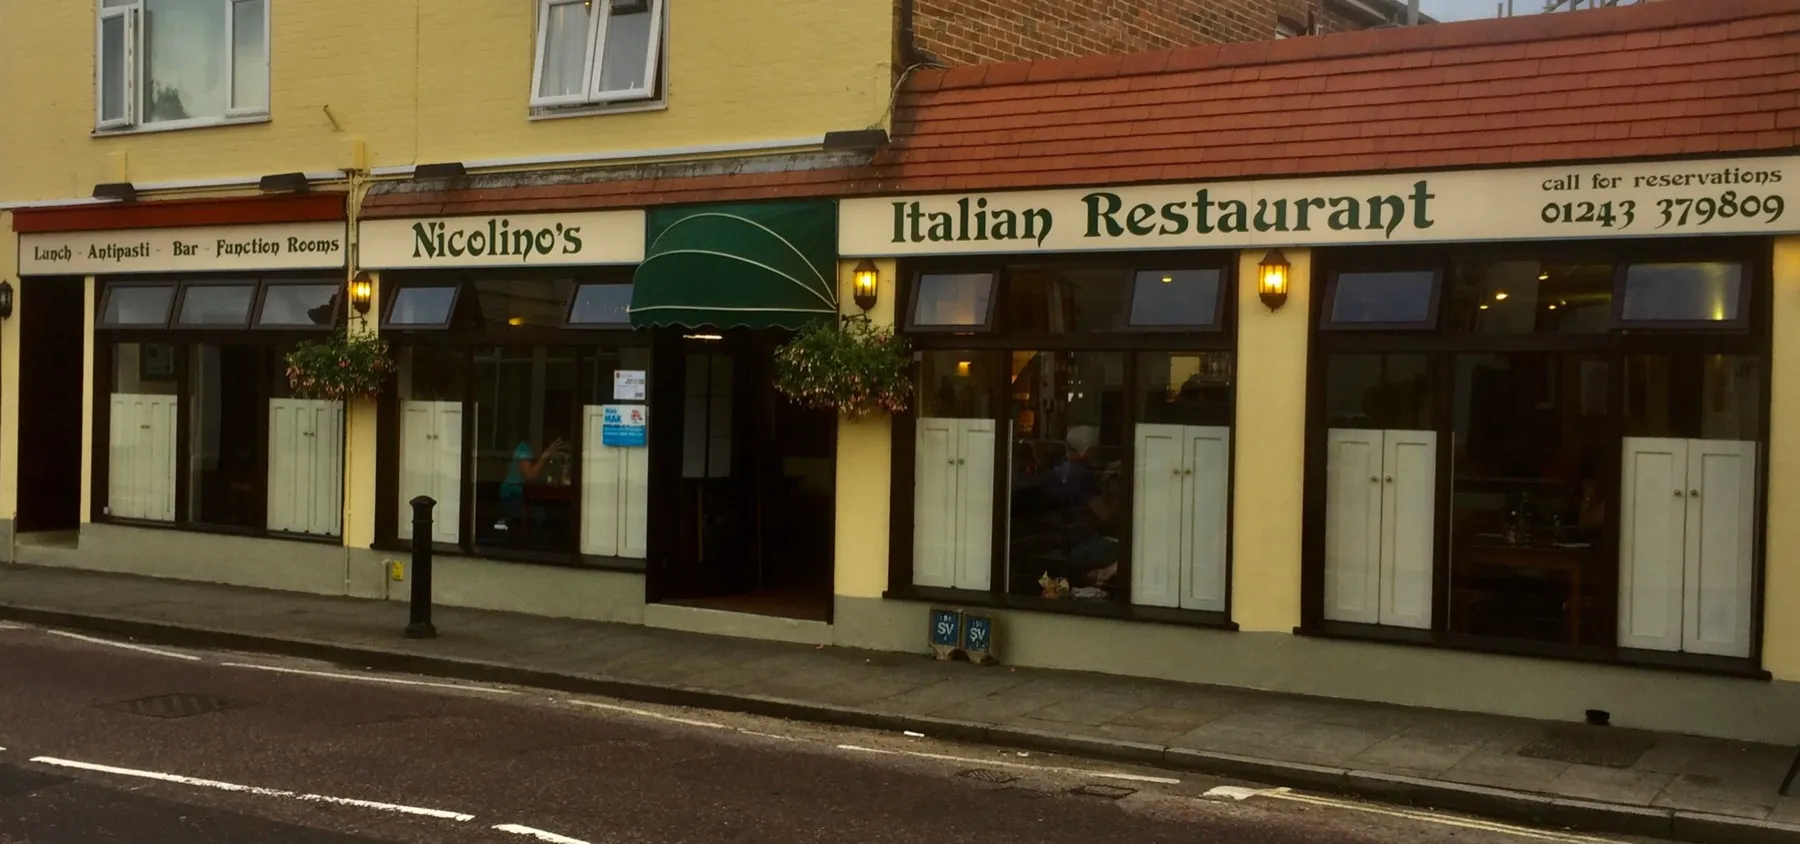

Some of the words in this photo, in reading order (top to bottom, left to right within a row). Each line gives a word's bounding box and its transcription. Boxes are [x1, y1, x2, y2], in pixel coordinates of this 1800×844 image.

[1541, 173, 1580, 191] call
[1591, 173, 1623, 190] for
[1633, 167, 1782, 188] reservations
[890, 196, 1054, 248] Italian
[1080, 179, 1436, 240] Restaurant
[1541, 200, 1636, 231] 01243
[1655, 190, 1785, 230] 379809
[34, 246, 72, 261] Lunch
[88, 241, 150, 262] Antipasti
[172, 241, 199, 257] Bar
[216, 238, 280, 258] Function
[287, 236, 340, 253] Rooms
[412, 218, 583, 262] Nicolino's
[937, 621, 955, 636] SV
[969, 627, 986, 641] SV
